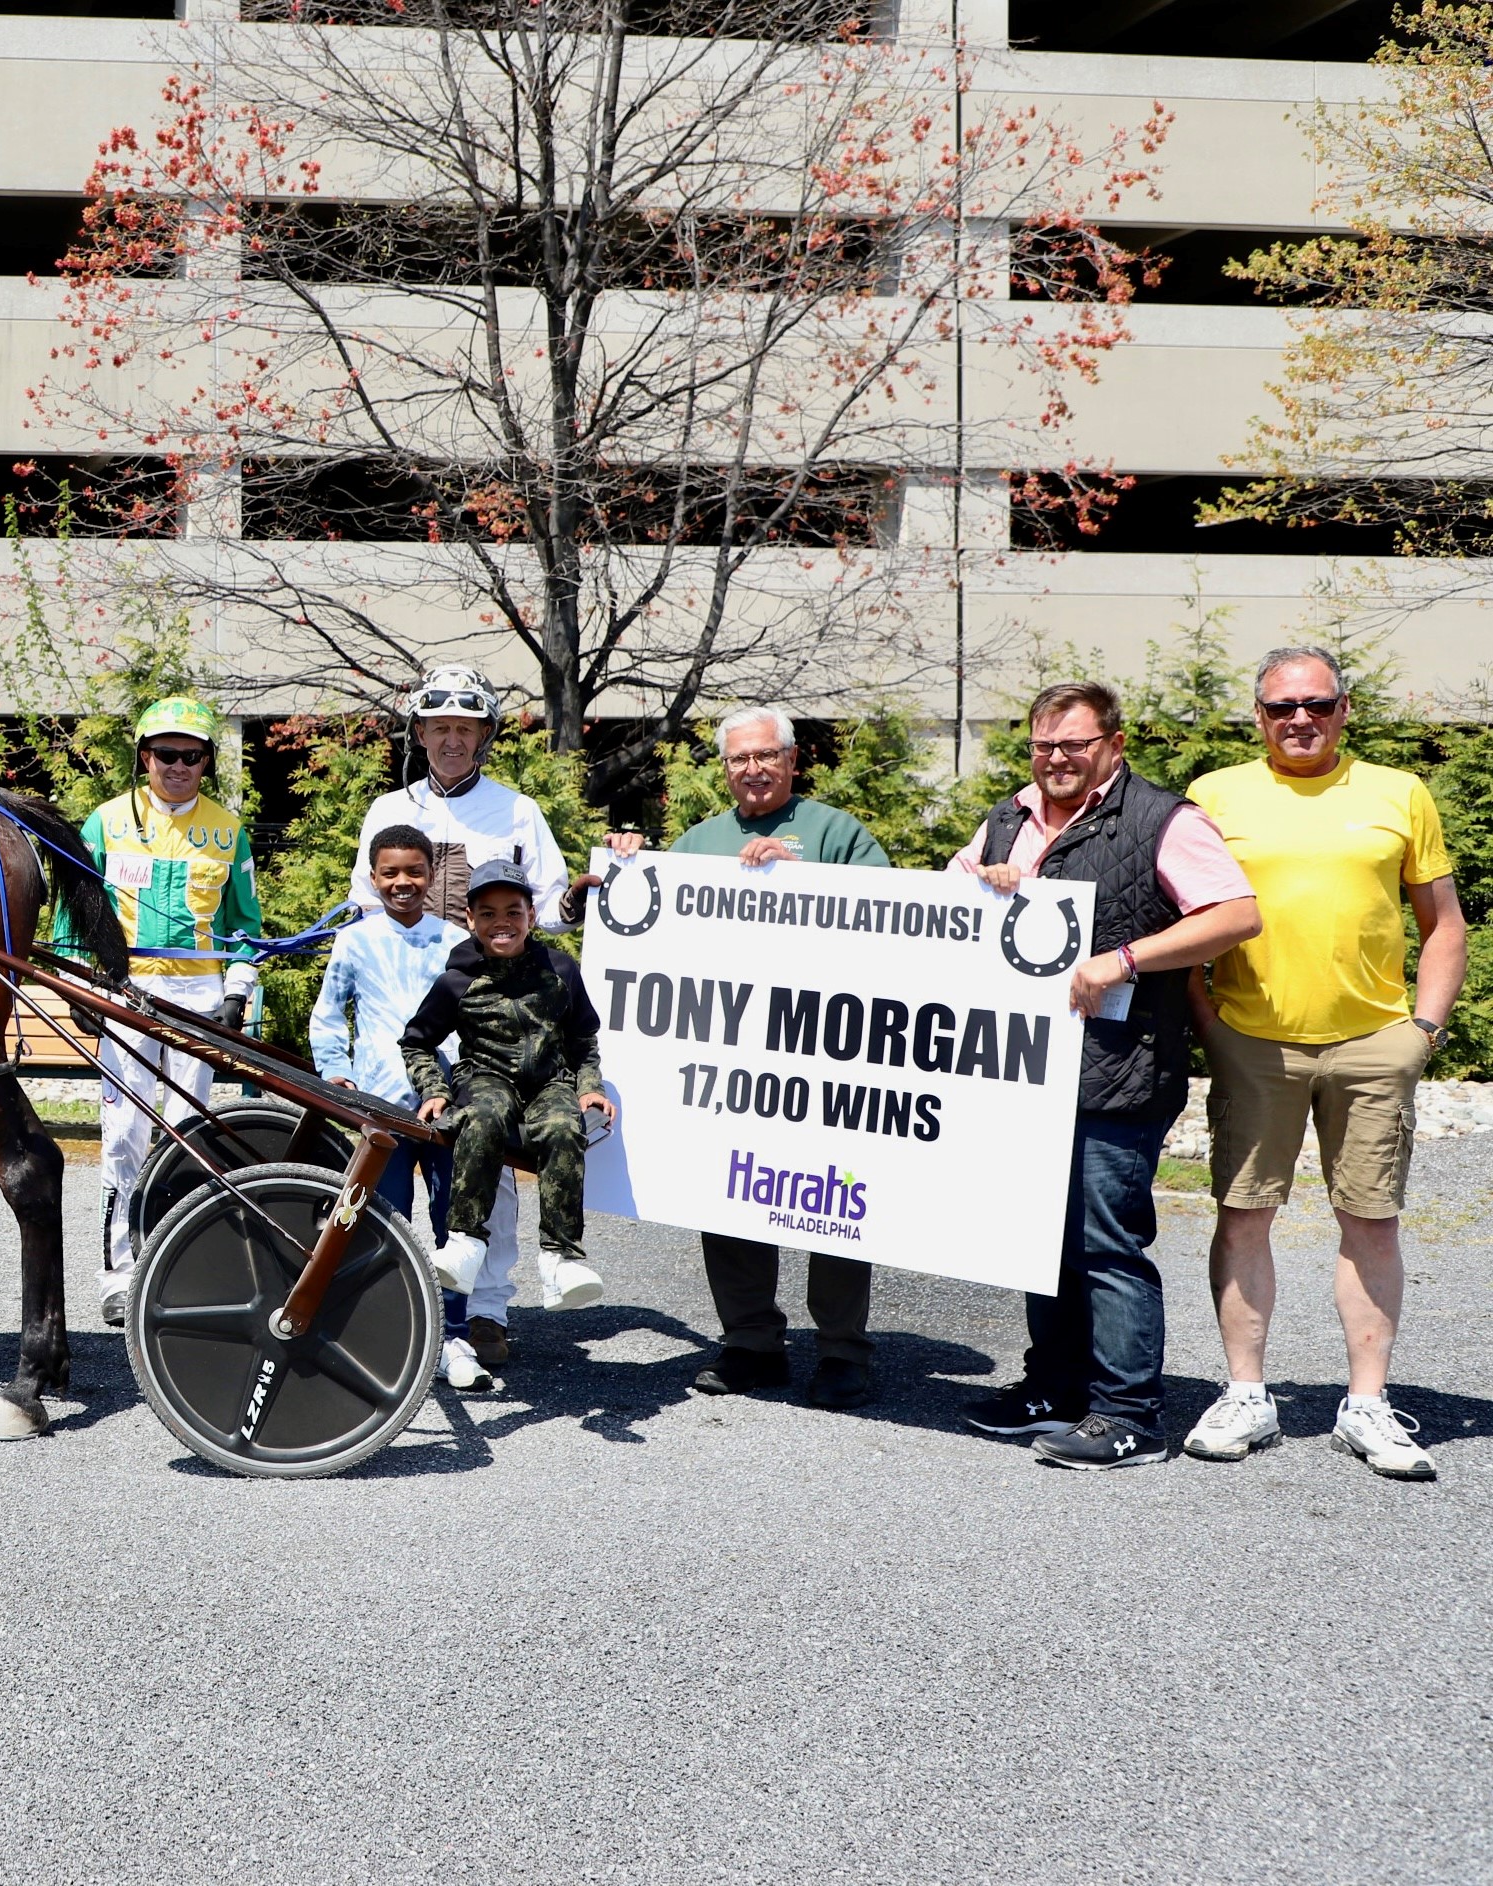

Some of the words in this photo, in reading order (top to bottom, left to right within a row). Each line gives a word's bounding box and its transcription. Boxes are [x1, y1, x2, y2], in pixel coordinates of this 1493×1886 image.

[675, 883, 983, 943] CONGRATULATIONS!
[604, 968, 755, 1047] TONY
[765, 986, 1051, 1086] MORGAN
[678, 1062, 810, 1123] 17,000
[822, 1080, 942, 1143] WINS
[768, 1210, 862, 1242] PHILADELPHIA
